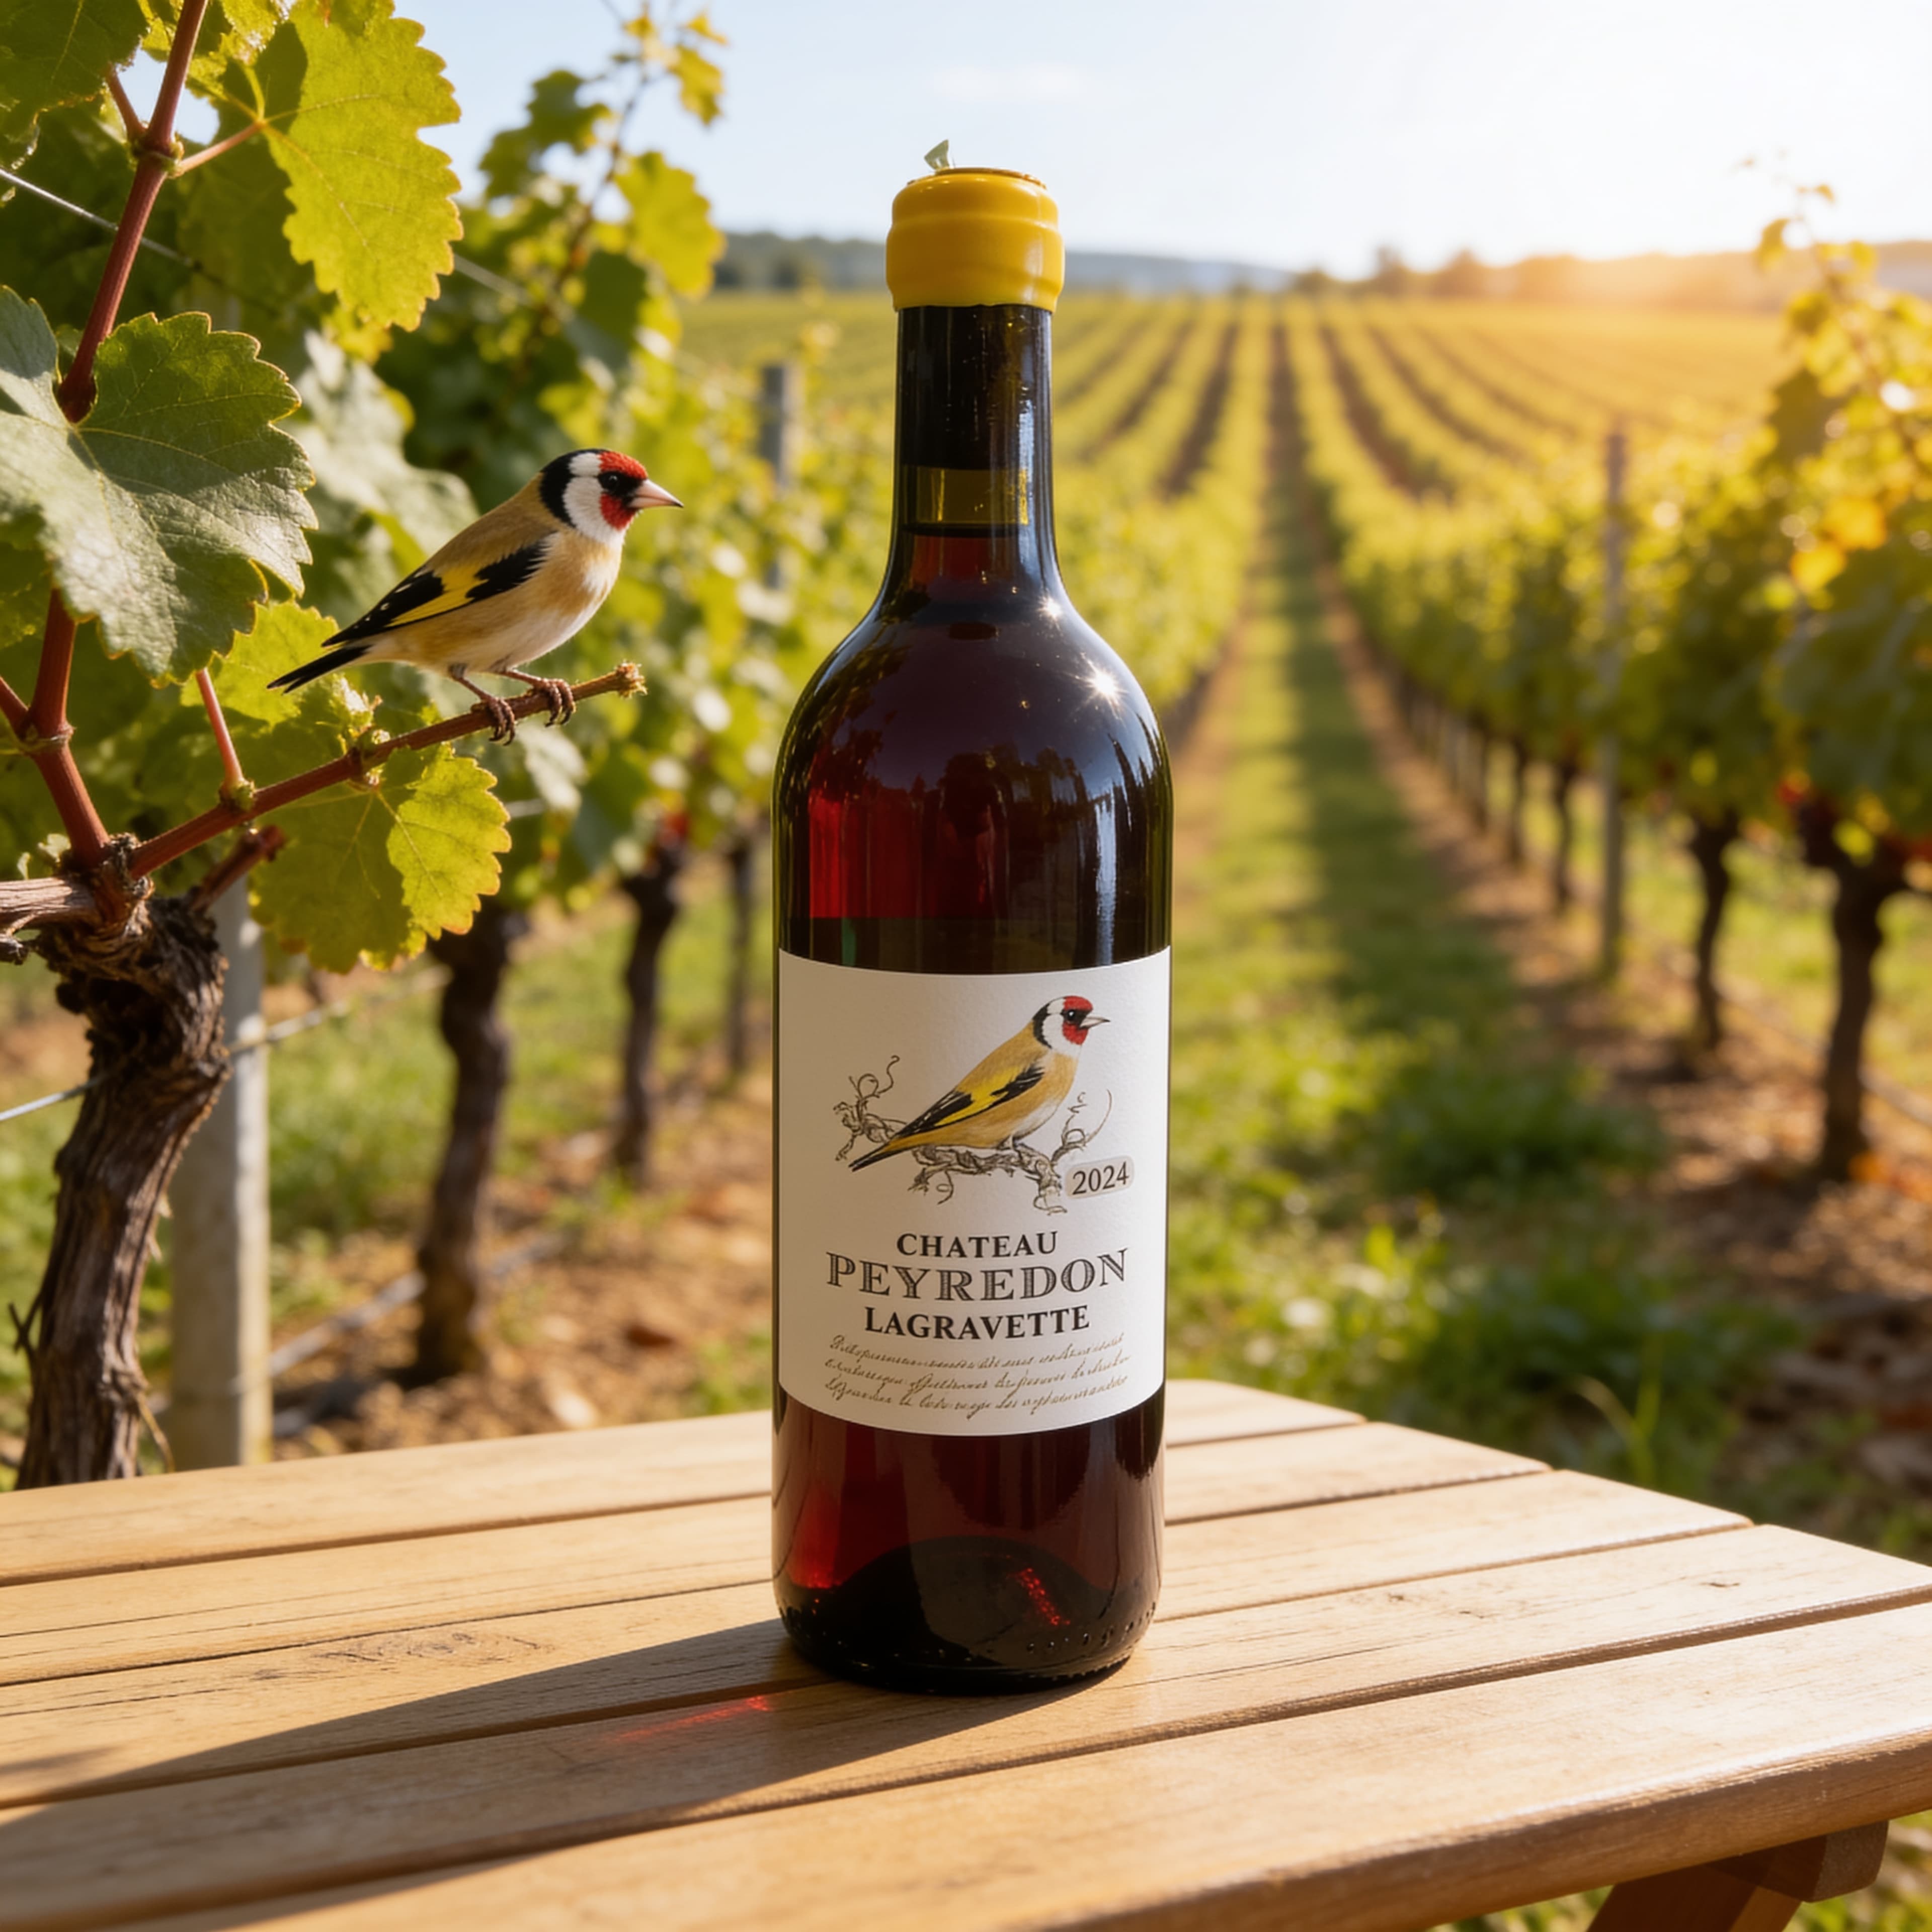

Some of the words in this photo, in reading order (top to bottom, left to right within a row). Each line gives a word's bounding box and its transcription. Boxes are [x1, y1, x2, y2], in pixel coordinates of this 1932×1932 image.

[1071, 1161, 1130, 1196] 2024
[896, 1231, 1058, 1259] CHATEAU
[826, 1248, 1128, 1302] PEYREDON
[864, 1304, 1090, 1340] LAGRAVETTE
